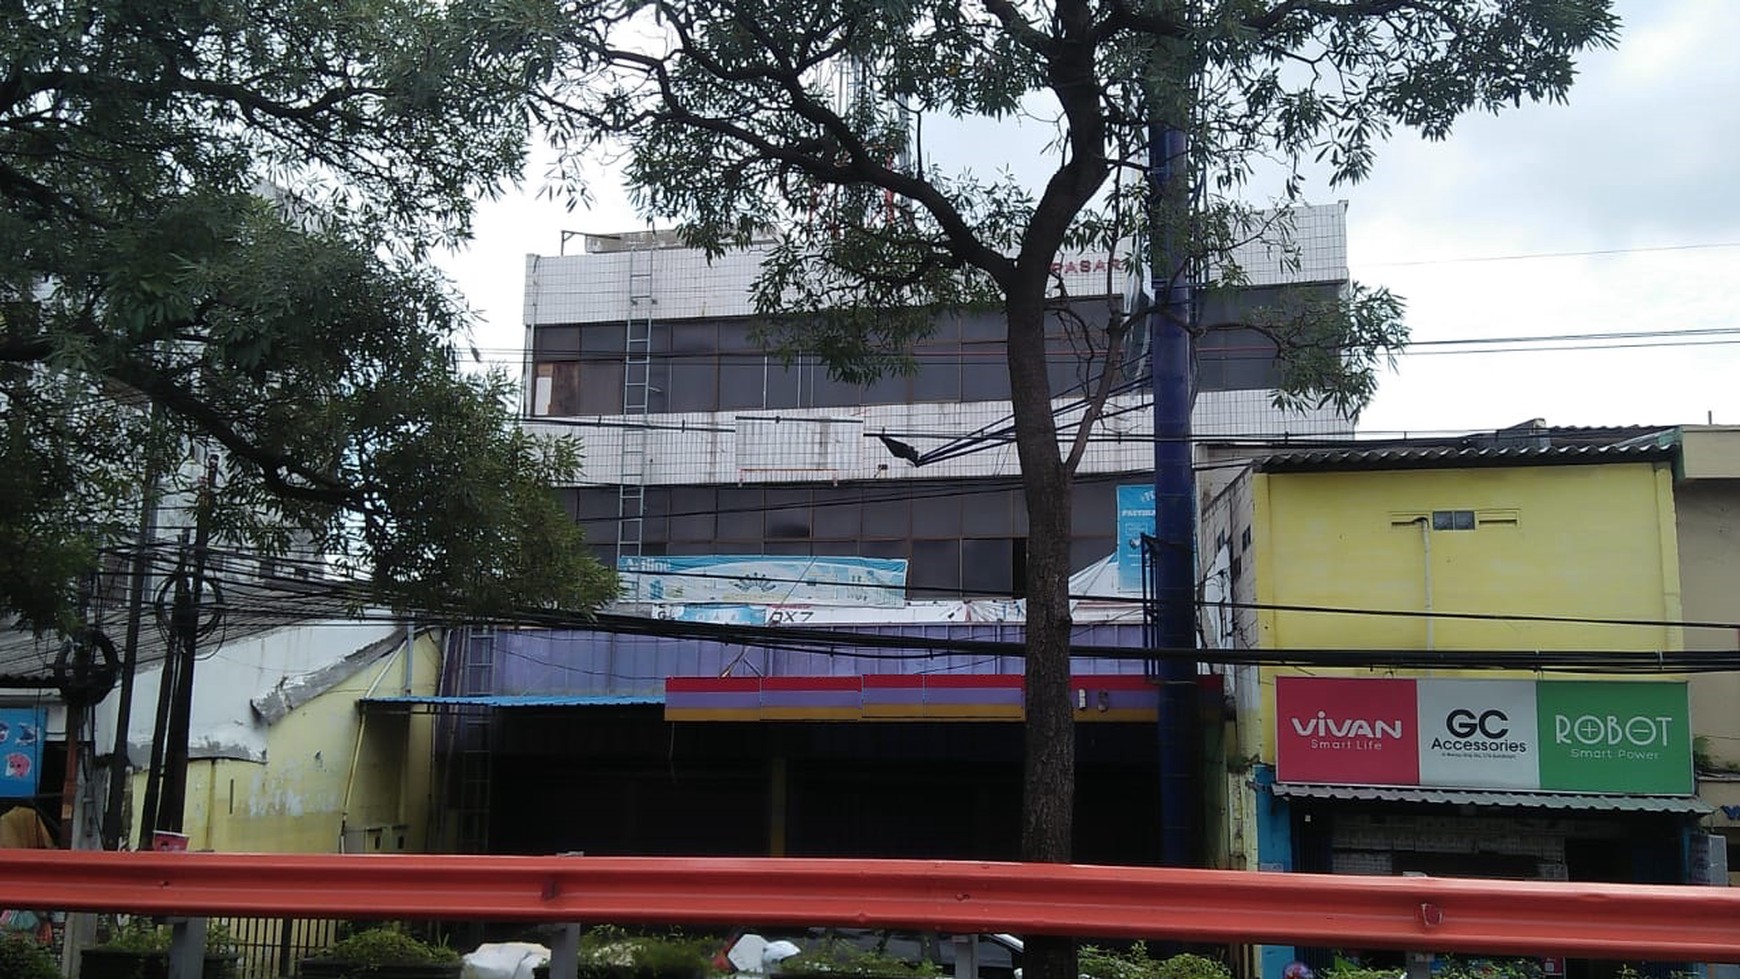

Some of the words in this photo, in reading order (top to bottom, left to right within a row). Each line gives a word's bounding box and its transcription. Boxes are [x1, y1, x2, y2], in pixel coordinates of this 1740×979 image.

[1446, 709, 1509, 739] GC
[1556, 715, 1672, 746] ROBOT
[1311, 740, 1351, 749] Smart
[1356, 741, 1382, 750] Life
[1431, 738, 1527, 753] Accessories
[1571, 749, 1612, 758] Smart
[1618, 750, 1660, 760] Power
